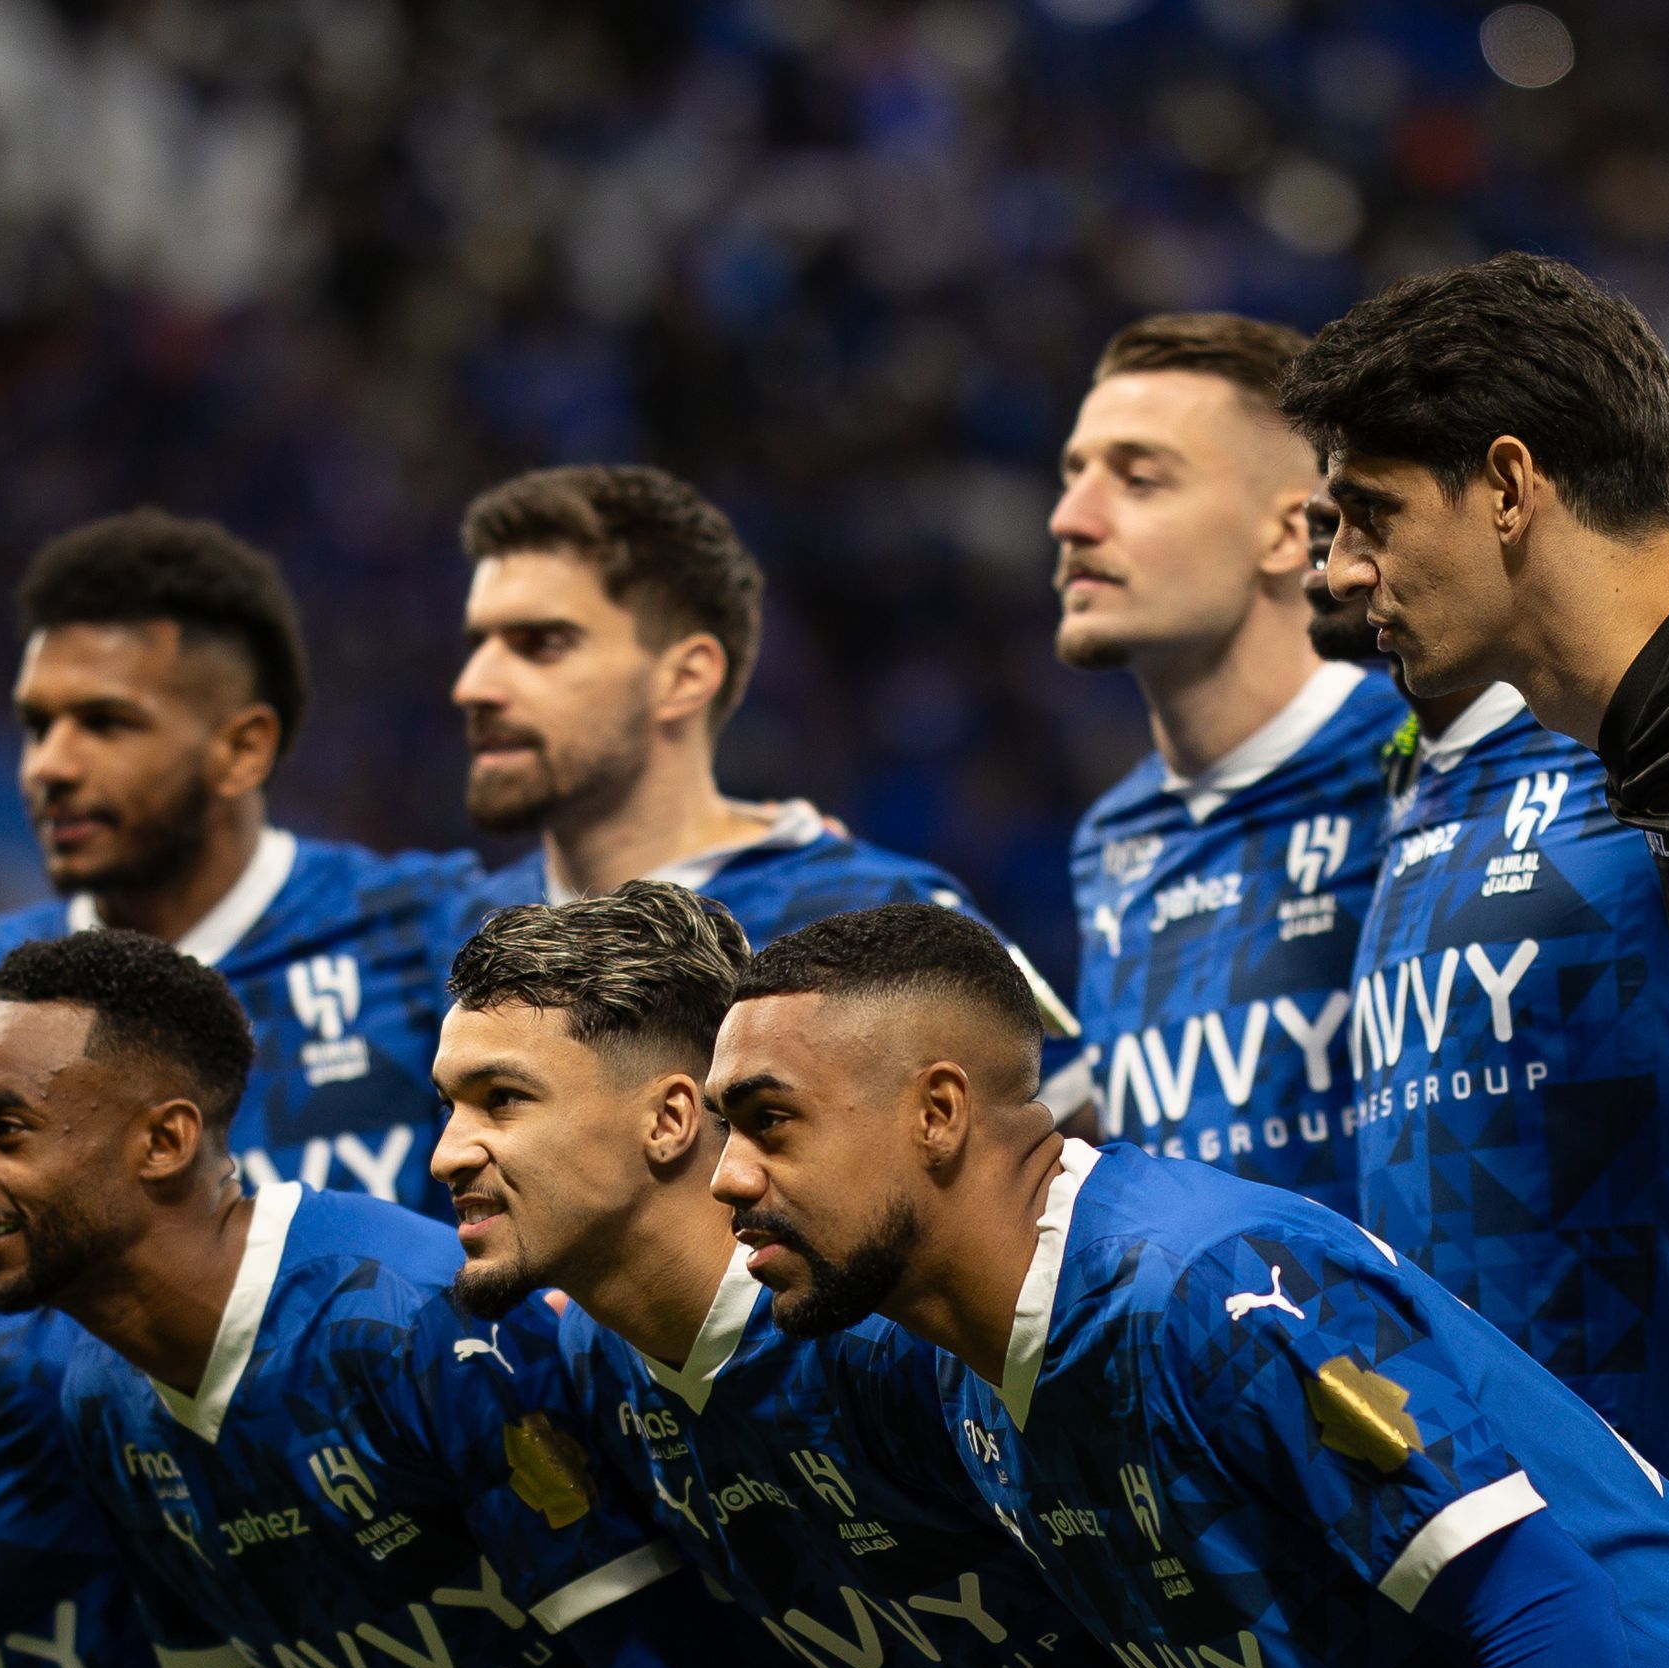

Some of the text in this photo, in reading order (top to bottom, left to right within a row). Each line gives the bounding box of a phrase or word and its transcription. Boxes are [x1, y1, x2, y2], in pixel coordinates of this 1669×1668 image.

[1404, 1062, 1548, 1110] GROUP
[355, 1511, 414, 1549] ALHILAL
[838, 1520, 890, 1540] ALHILAL
